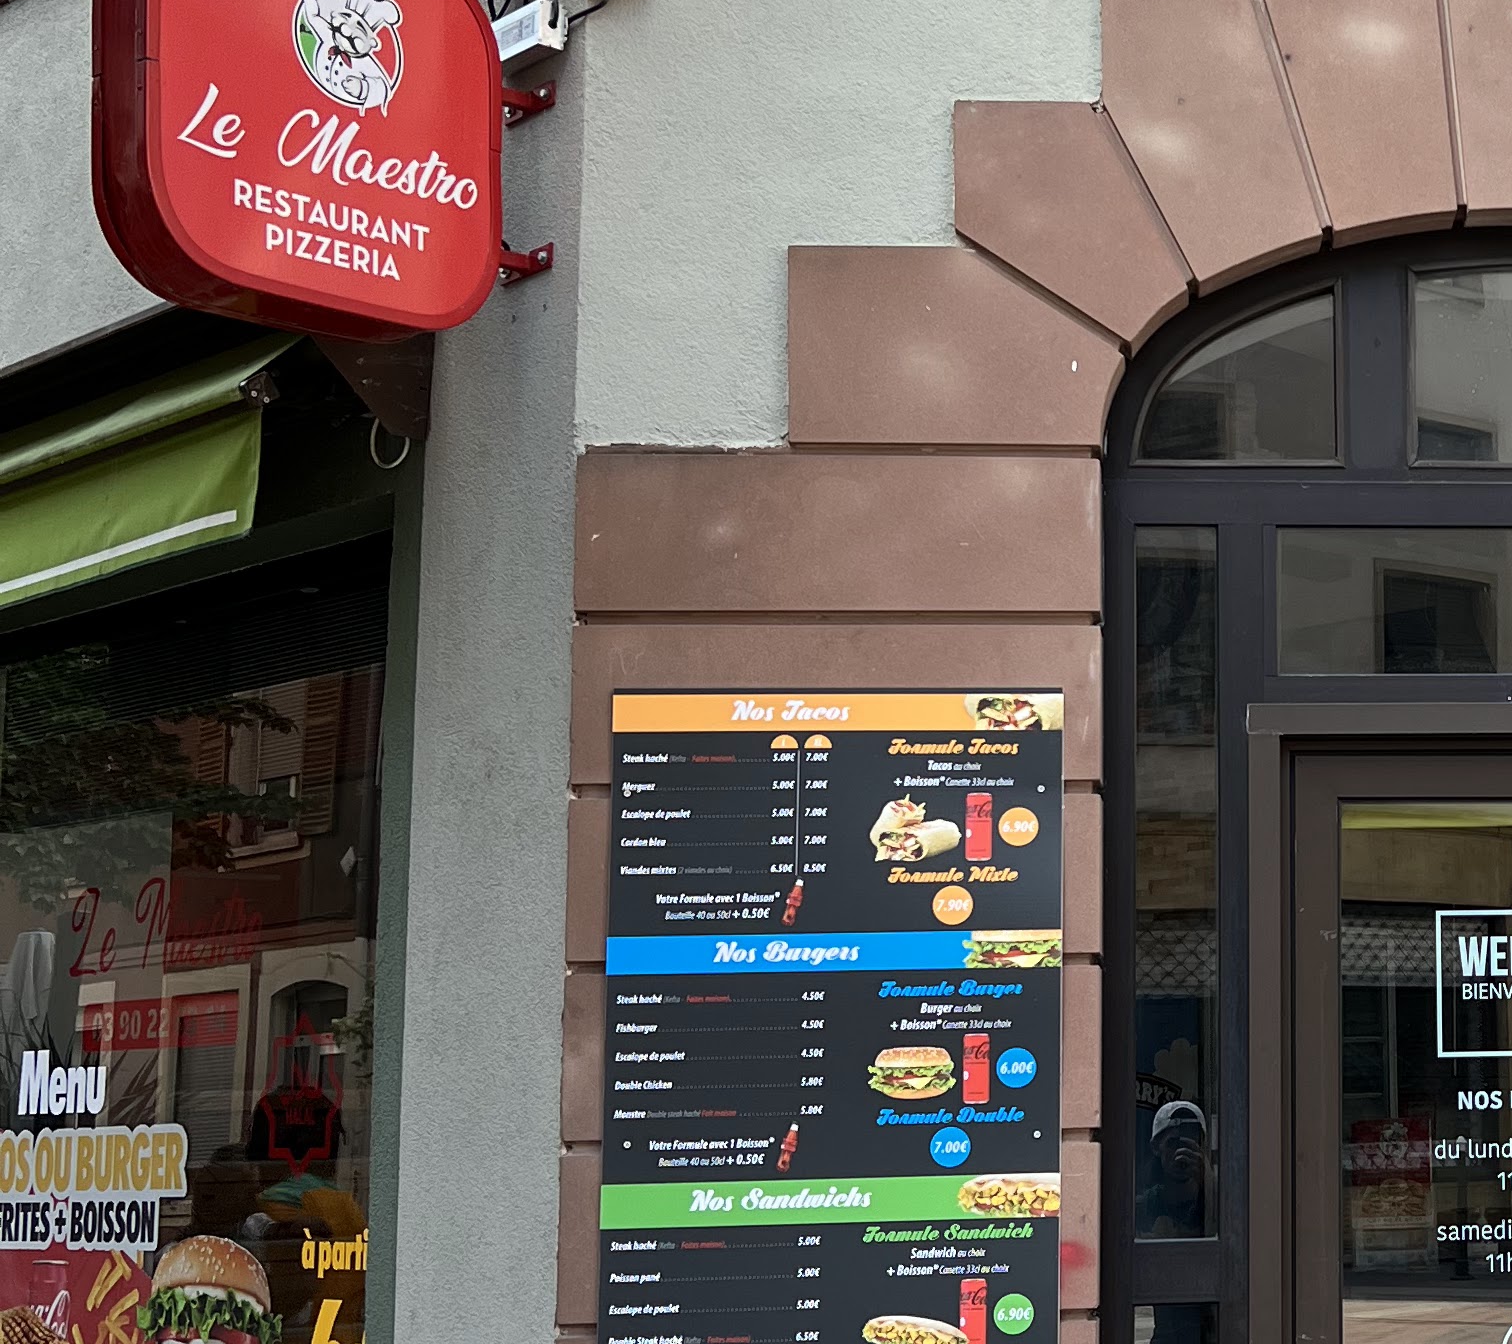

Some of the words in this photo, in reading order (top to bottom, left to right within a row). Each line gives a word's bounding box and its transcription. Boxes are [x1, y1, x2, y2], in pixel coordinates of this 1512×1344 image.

[177, 83, 246, 158] Le
[277, 108, 478, 210] Maestro
[234, 179, 430, 252] RESTAURANT
[266, 223, 401, 280] PIZZERIA
[732, 700, 774, 721] Nos
[784, 699, 850, 721] Tacos
[888, 739, 964, 755] Formule
[968, 738, 1018, 755] Tacos
[1003, 821, 1035, 832] 6.90€
[888, 867, 964, 883] Formule
[969, 866, 1018, 882] Mixte
[936, 900, 969, 912] 7.90€
[713, 942, 756, 964] Nos
[763, 941, 860, 965] Burgers
[879, 981, 954, 998] Formule
[959, 980, 1023, 998] Burger
[801, 1020, 824, 1029] 4.50€
[801, 1049, 824, 1057] 4.50€
[1001, 1062, 1033, 1074] 6.00€
[18, 1050, 107, 1116] Menu
[1458, 1090, 1503, 1110] NOS
[877, 1109, 953, 1125] Formule
[957, 1107, 1024, 1123] Double
[934, 1141, 968, 1153] 7.00€
[1435, 1139, 1462, 1160] du
[34, 1136, 72, 1192] OU
[75, 1132, 183, 1192] BURGER
[689, 1189, 732, 1212] Nos
[741, 1187, 872, 1210] Sandwichs
[54, 1208, 66, 1235] +
[70, 1200, 155, 1243] BOISSON
[1437, 1221, 1512, 1242] samedi
[863, 1226, 939, 1243] Formule
[944, 1223, 1034, 1240] Sandwich
[302, 1228, 315, 1269] à
[997, 1308, 1032, 1321] 6.90€
